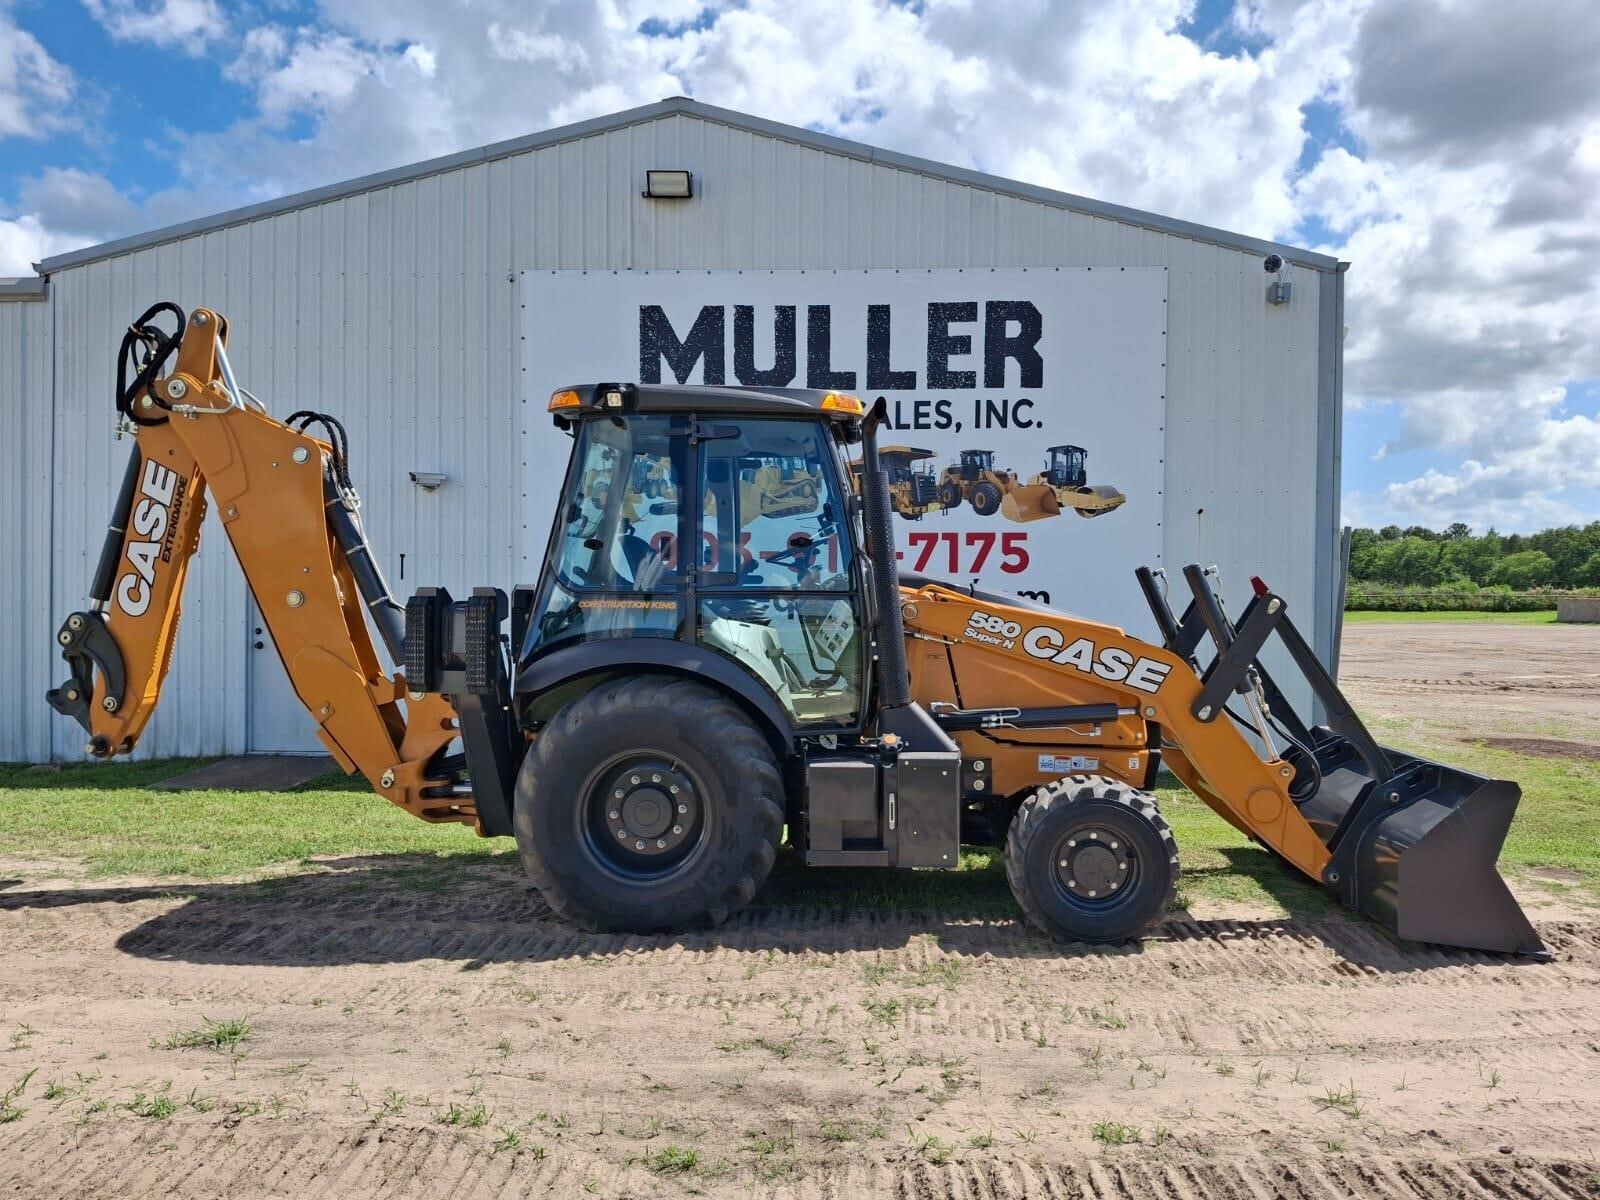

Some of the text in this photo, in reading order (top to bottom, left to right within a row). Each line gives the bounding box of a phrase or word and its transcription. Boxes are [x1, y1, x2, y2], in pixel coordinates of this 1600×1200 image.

[639, 300, 1043, 390] MULLER
[859, 399, 1043, 433] LES, INC.
[117, 457, 178, 617] CASE
[161, 475, 188, 564] EXTENDAHOE
[578, 600, 677, 610] CONSTRUCTION KING
[968, 610, 1022, 638] 580
[1003, 637, 1017, 650] N
[1022, 625, 1173, 694] CASE
